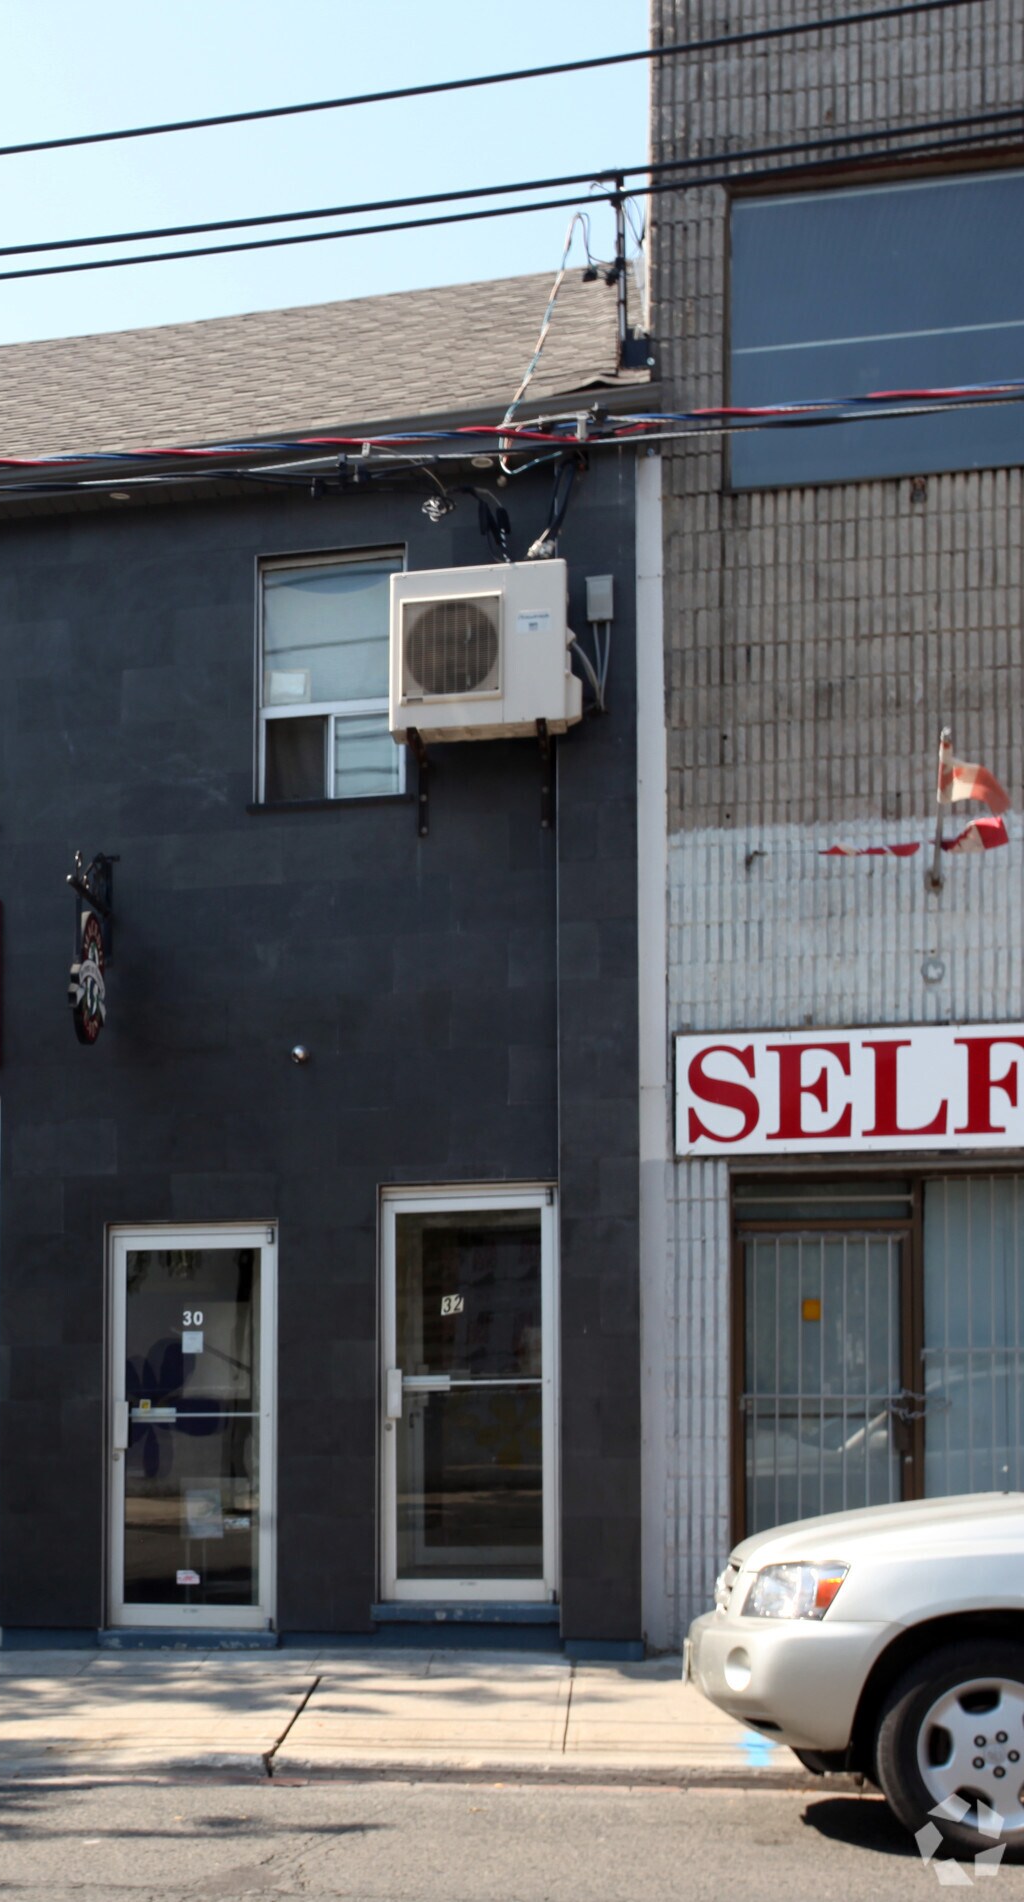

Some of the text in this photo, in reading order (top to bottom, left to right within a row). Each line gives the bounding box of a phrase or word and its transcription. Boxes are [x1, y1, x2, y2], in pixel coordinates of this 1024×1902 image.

[687, 1036, 1024, 1143] SELF
[443, 1295, 462, 1314] 32
[182, 1310, 204, 1326] 30
